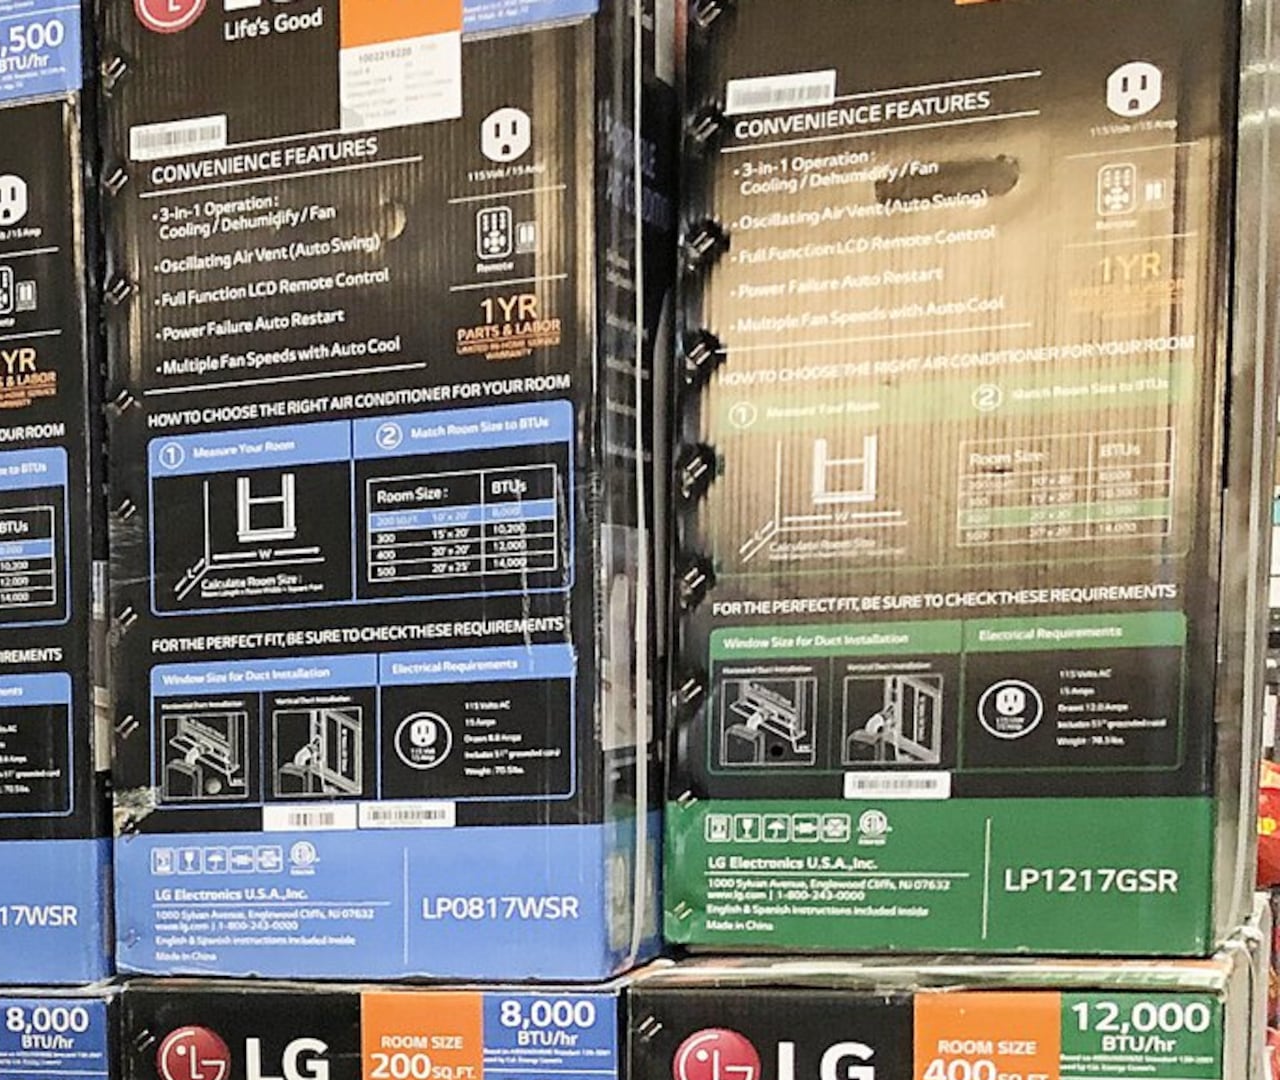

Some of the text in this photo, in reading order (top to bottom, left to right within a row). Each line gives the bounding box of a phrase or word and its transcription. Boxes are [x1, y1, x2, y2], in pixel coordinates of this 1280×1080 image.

[224, 10, 322, 41] Life's Good
[735, 90, 990, 139] CONVENIENCE FEATURES
[152, 136, 378, 185] CONVENIENCE FEATURES
[1004, 869, 1178, 892] LP1217GSR
[422, 897, 579, 919] LP0817WSR
[6, 1007, 89, 1035] 8,000
[499, 1000, 595, 1031] 8,000
[1072, 1001, 1210, 1036] 12,000
[22, 1034, 74, 1050] BTU/hr
[381, 1034, 463, 1050] ROOM SIZE
[517, 1029, 578, 1048] BTU/hr
[938, 1038, 1036, 1056] ROOM SIZE
[1102, 1035, 1176, 1054] BTU/hr
[371, 1052, 431, 1080] 200
